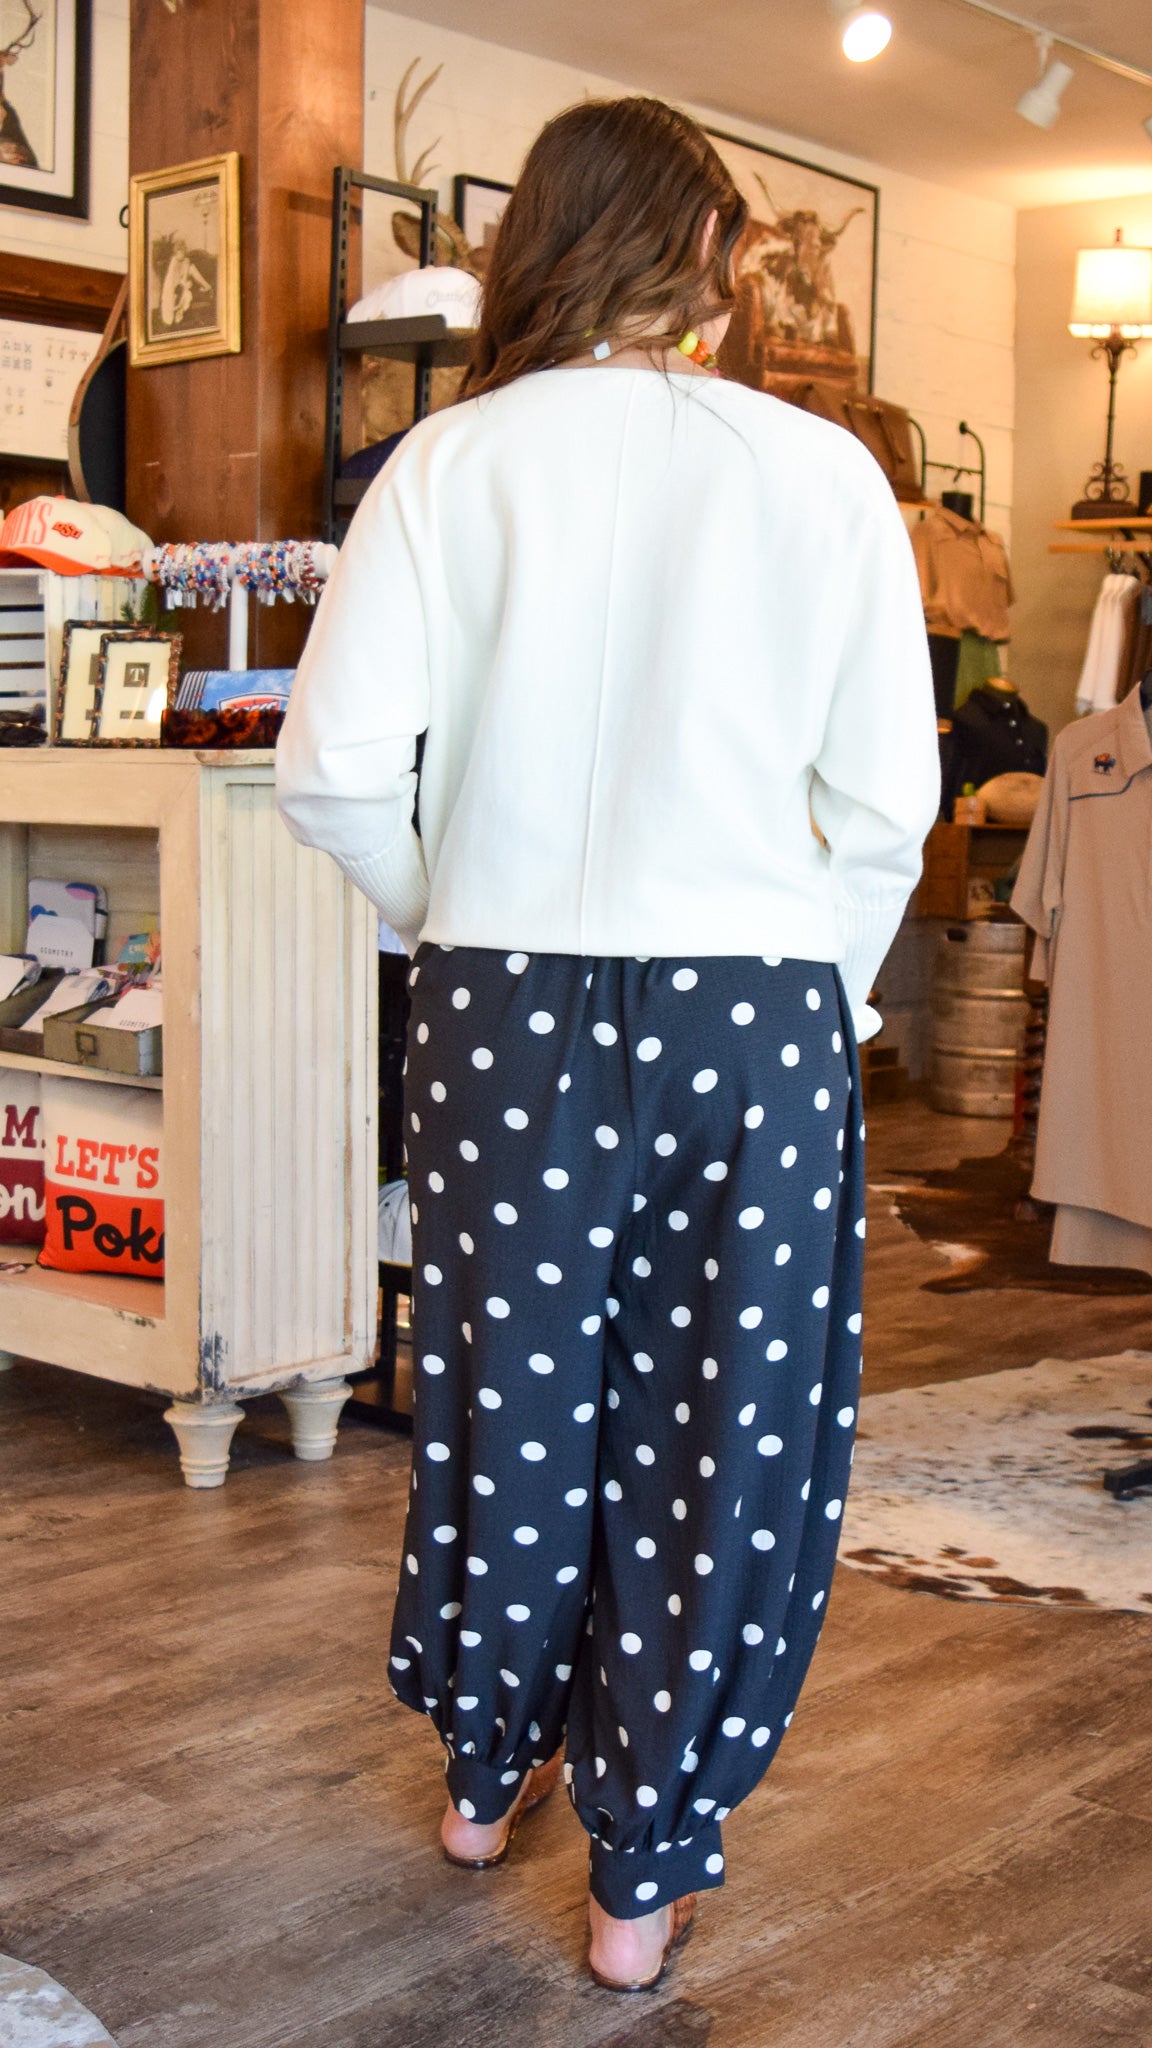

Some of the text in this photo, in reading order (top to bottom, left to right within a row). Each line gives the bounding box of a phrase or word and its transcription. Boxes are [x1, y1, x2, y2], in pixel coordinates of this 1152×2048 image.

[52, 521, 84, 540] OSU
[130, 668, 145, 682] T
[55, 1134, 160, 1189] LET'S
[56, 1195, 165, 1263] Pok
